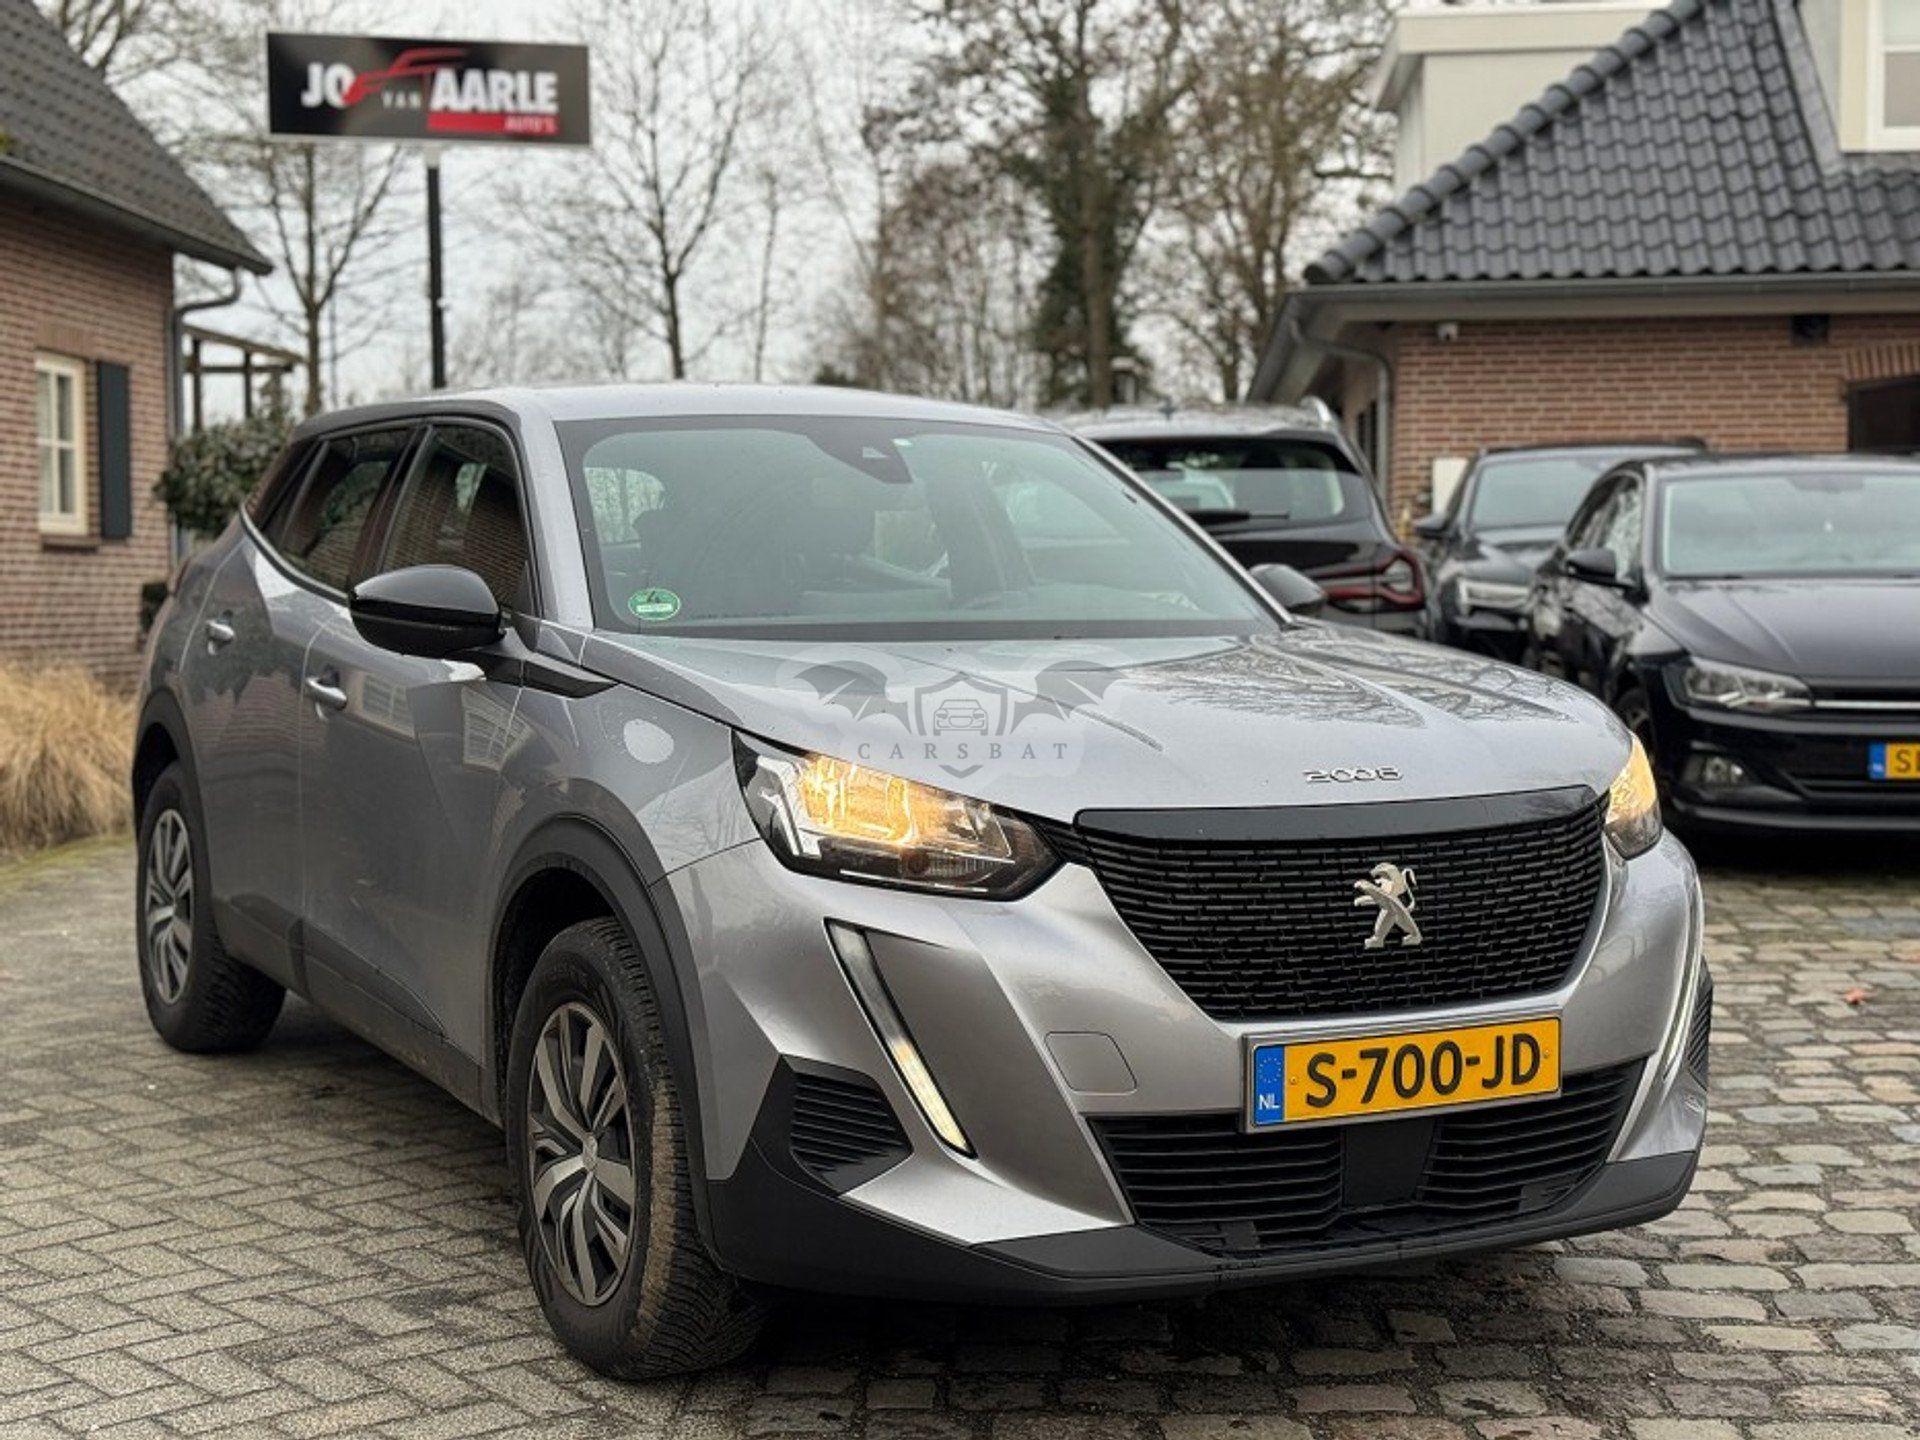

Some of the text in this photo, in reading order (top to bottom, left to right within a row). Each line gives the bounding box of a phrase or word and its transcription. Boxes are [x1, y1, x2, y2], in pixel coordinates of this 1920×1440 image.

[301, 63, 355, 109] JO
[430, 68, 559, 113] AARLE
[1303, 765, 1404, 784] 2008
[1895, 748, 1920, 774] S
[1259, 1033, 1542, 1111] NL S-700-JD
